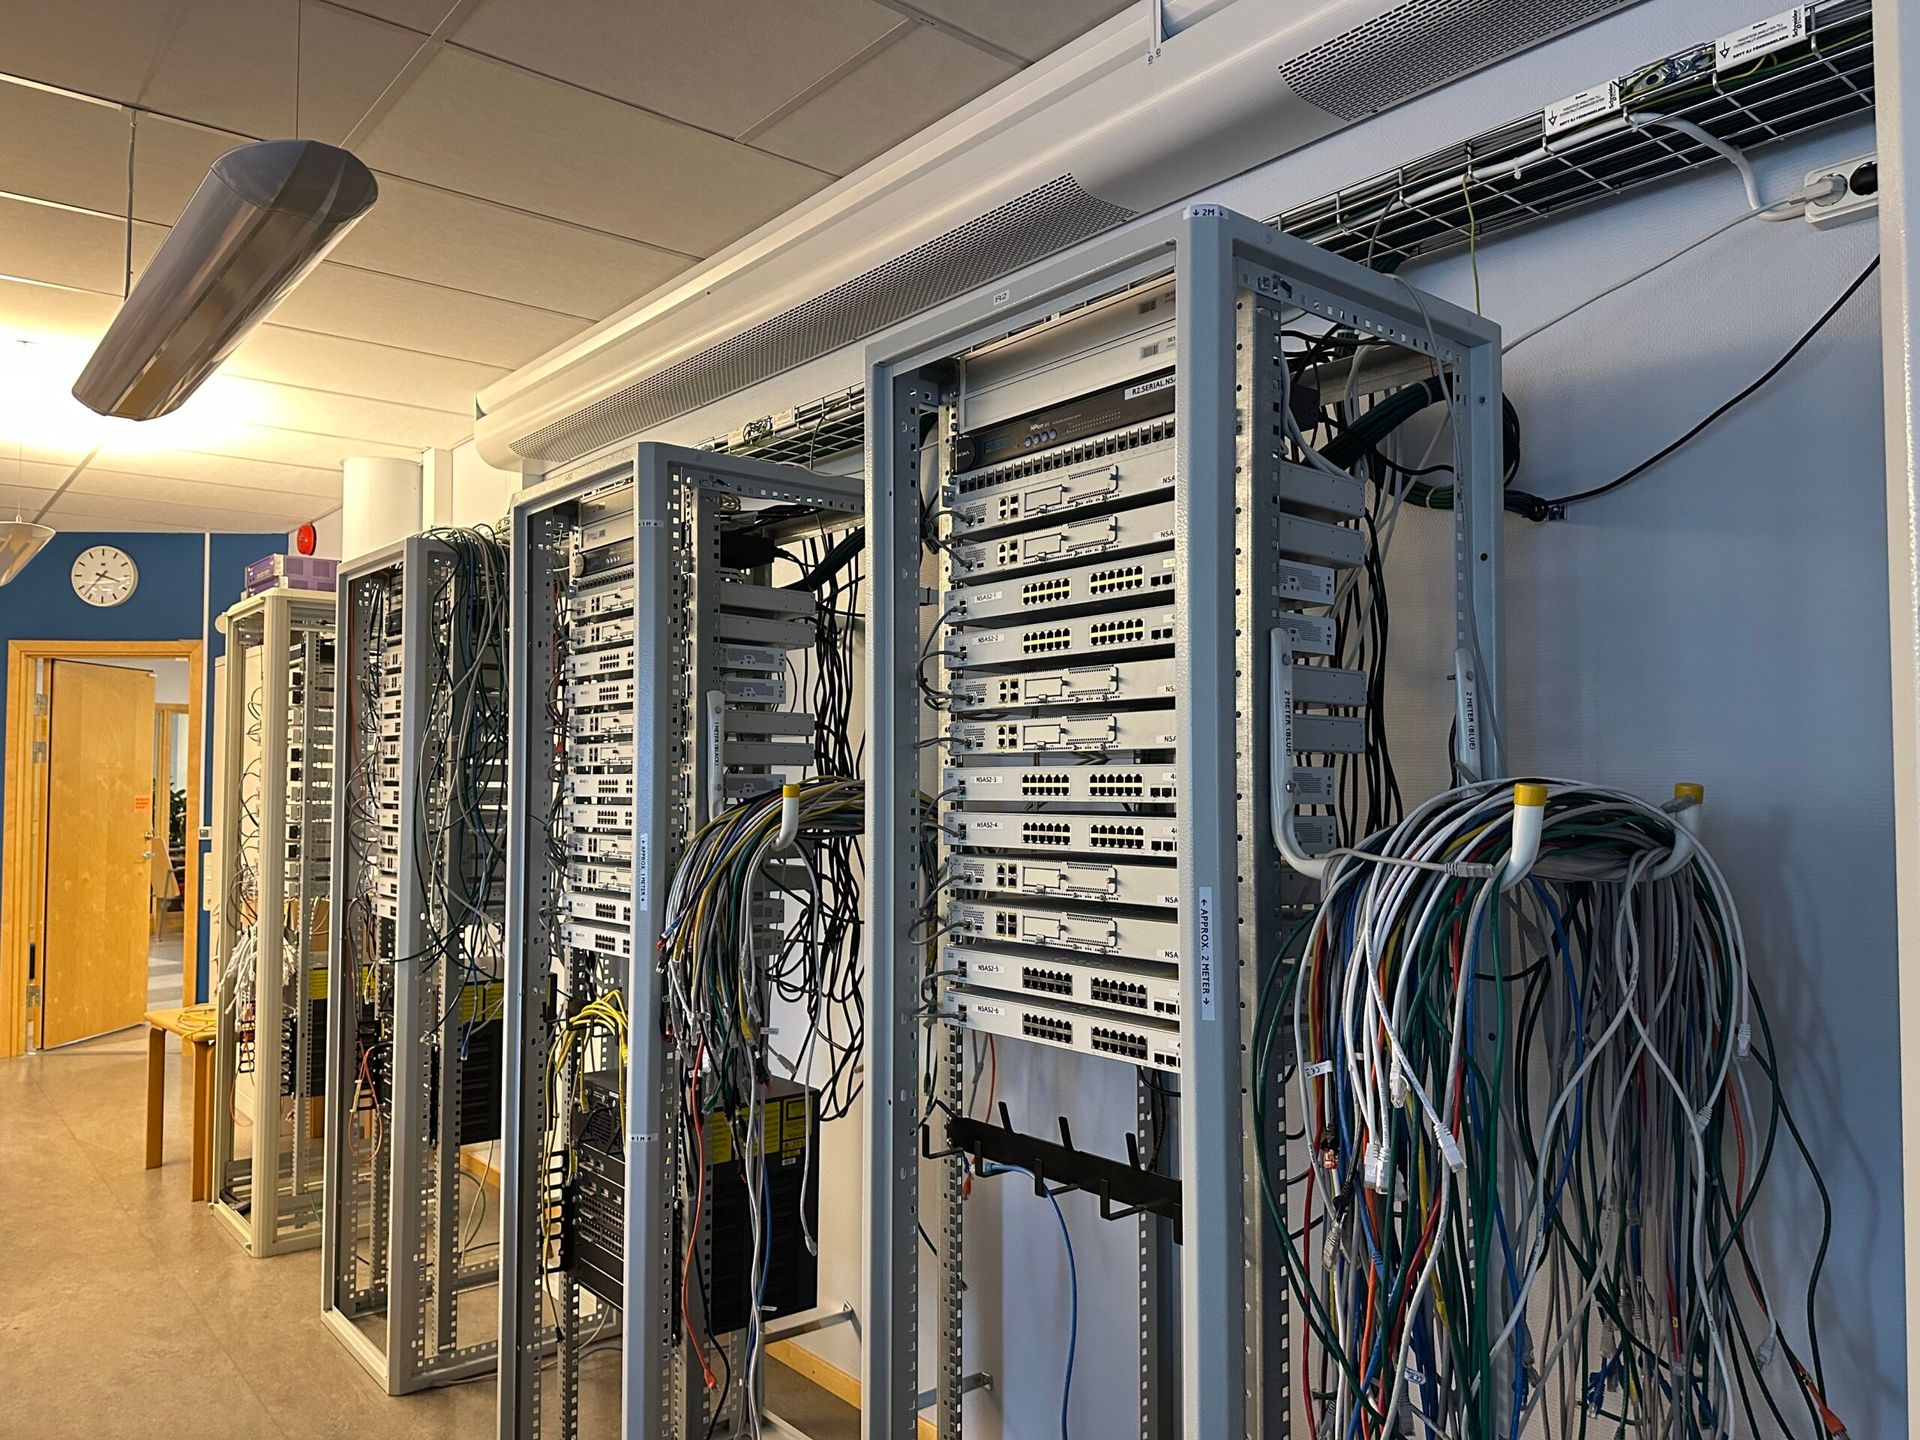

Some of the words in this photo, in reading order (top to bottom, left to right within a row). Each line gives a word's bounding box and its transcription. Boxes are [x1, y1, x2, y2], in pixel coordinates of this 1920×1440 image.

[1202, 208, 1215, 216] 2M
[995, 292, 1007, 303] R2
[1132, 376, 1176, 396] R2.SERIAL.NS
[977, 634, 999, 643] NSAS2-2
[1466, 697, 1474, 723] METER
[1468, 725, 1476, 750] (BLUE)
[1200, 908, 1209, 951] APPROX.
[977, 964, 1000, 973] NSAS2-5
[1202, 963, 1210, 995] METER
[977, 1005, 1000, 1014] NSAS2-6
